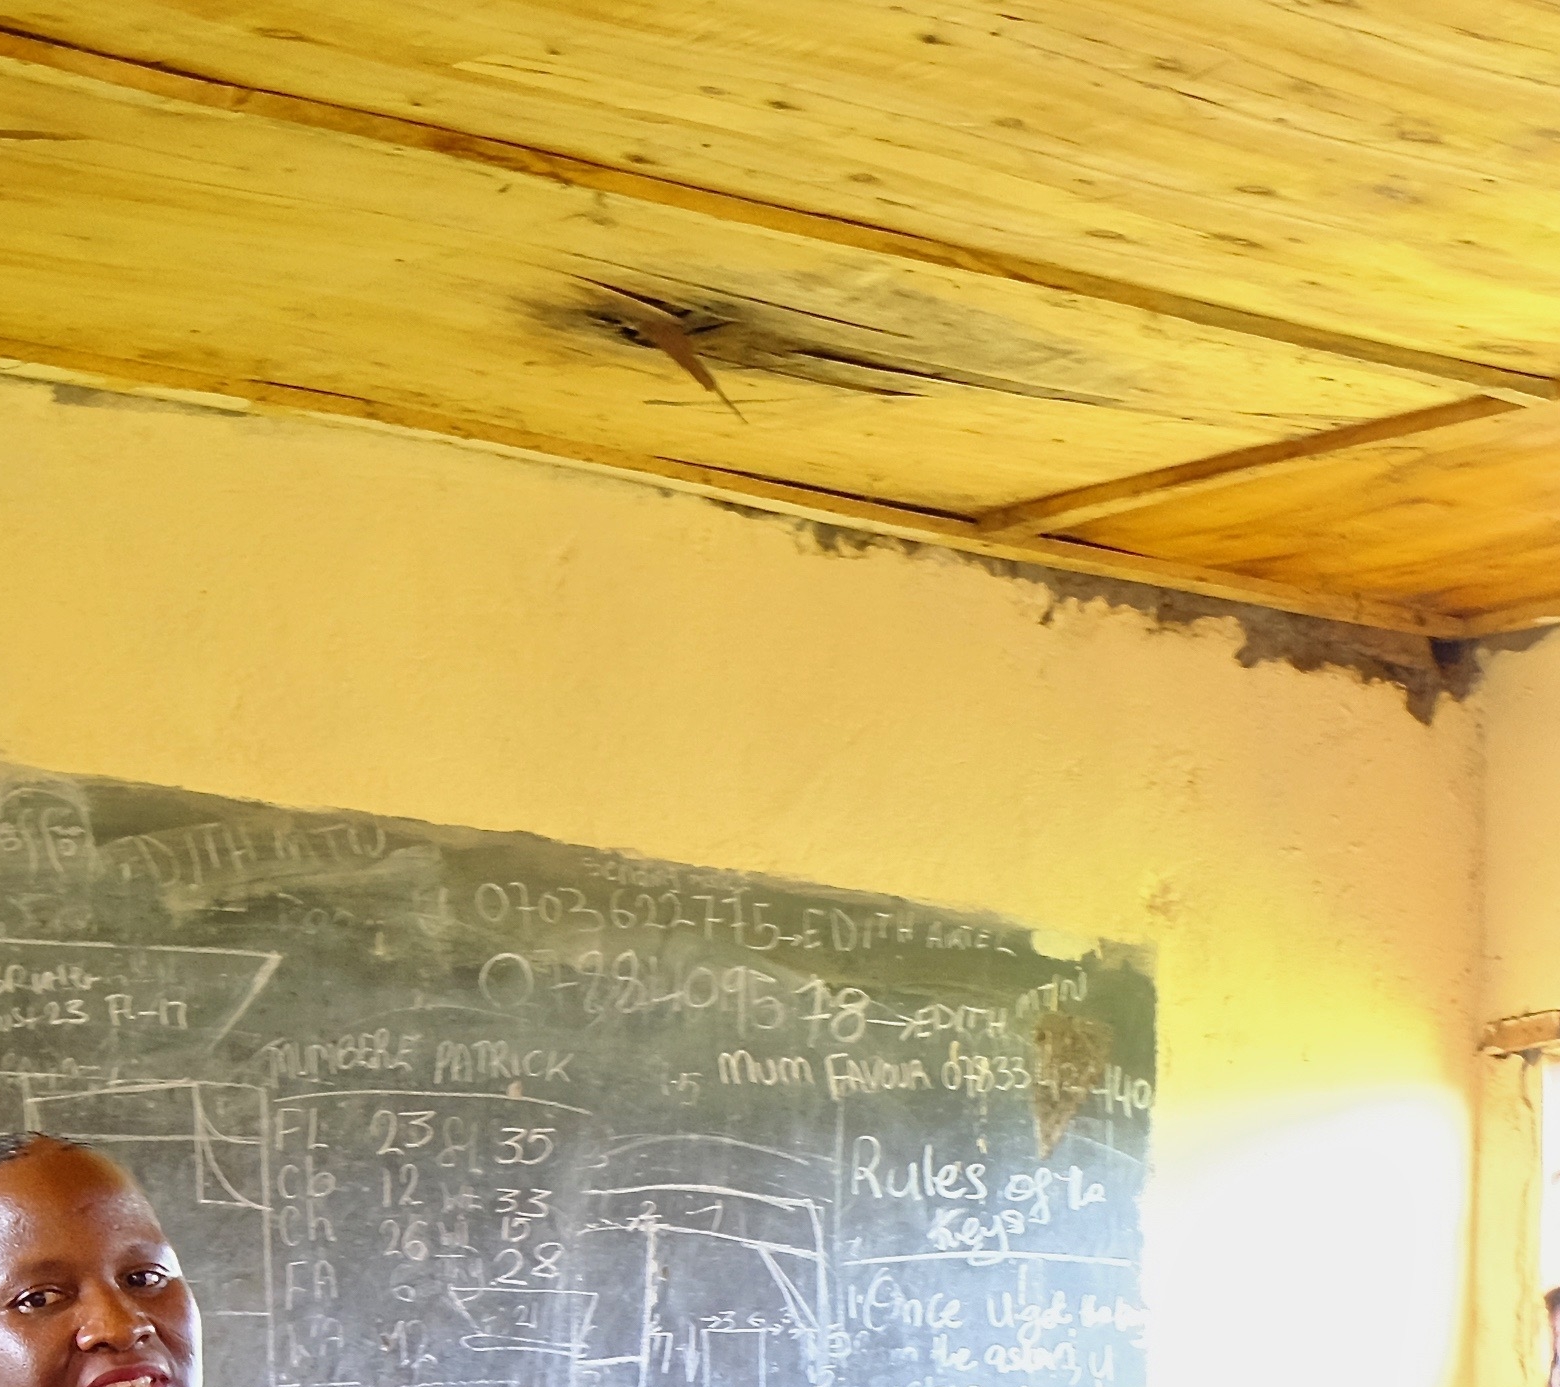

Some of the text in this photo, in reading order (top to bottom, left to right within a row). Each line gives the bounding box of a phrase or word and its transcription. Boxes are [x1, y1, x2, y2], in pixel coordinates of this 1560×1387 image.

[433, 1036, 576, 1085] PATRICK
[494, 1126, 558, 1166] 35
[848, 1134, 989, 1201] Rules
